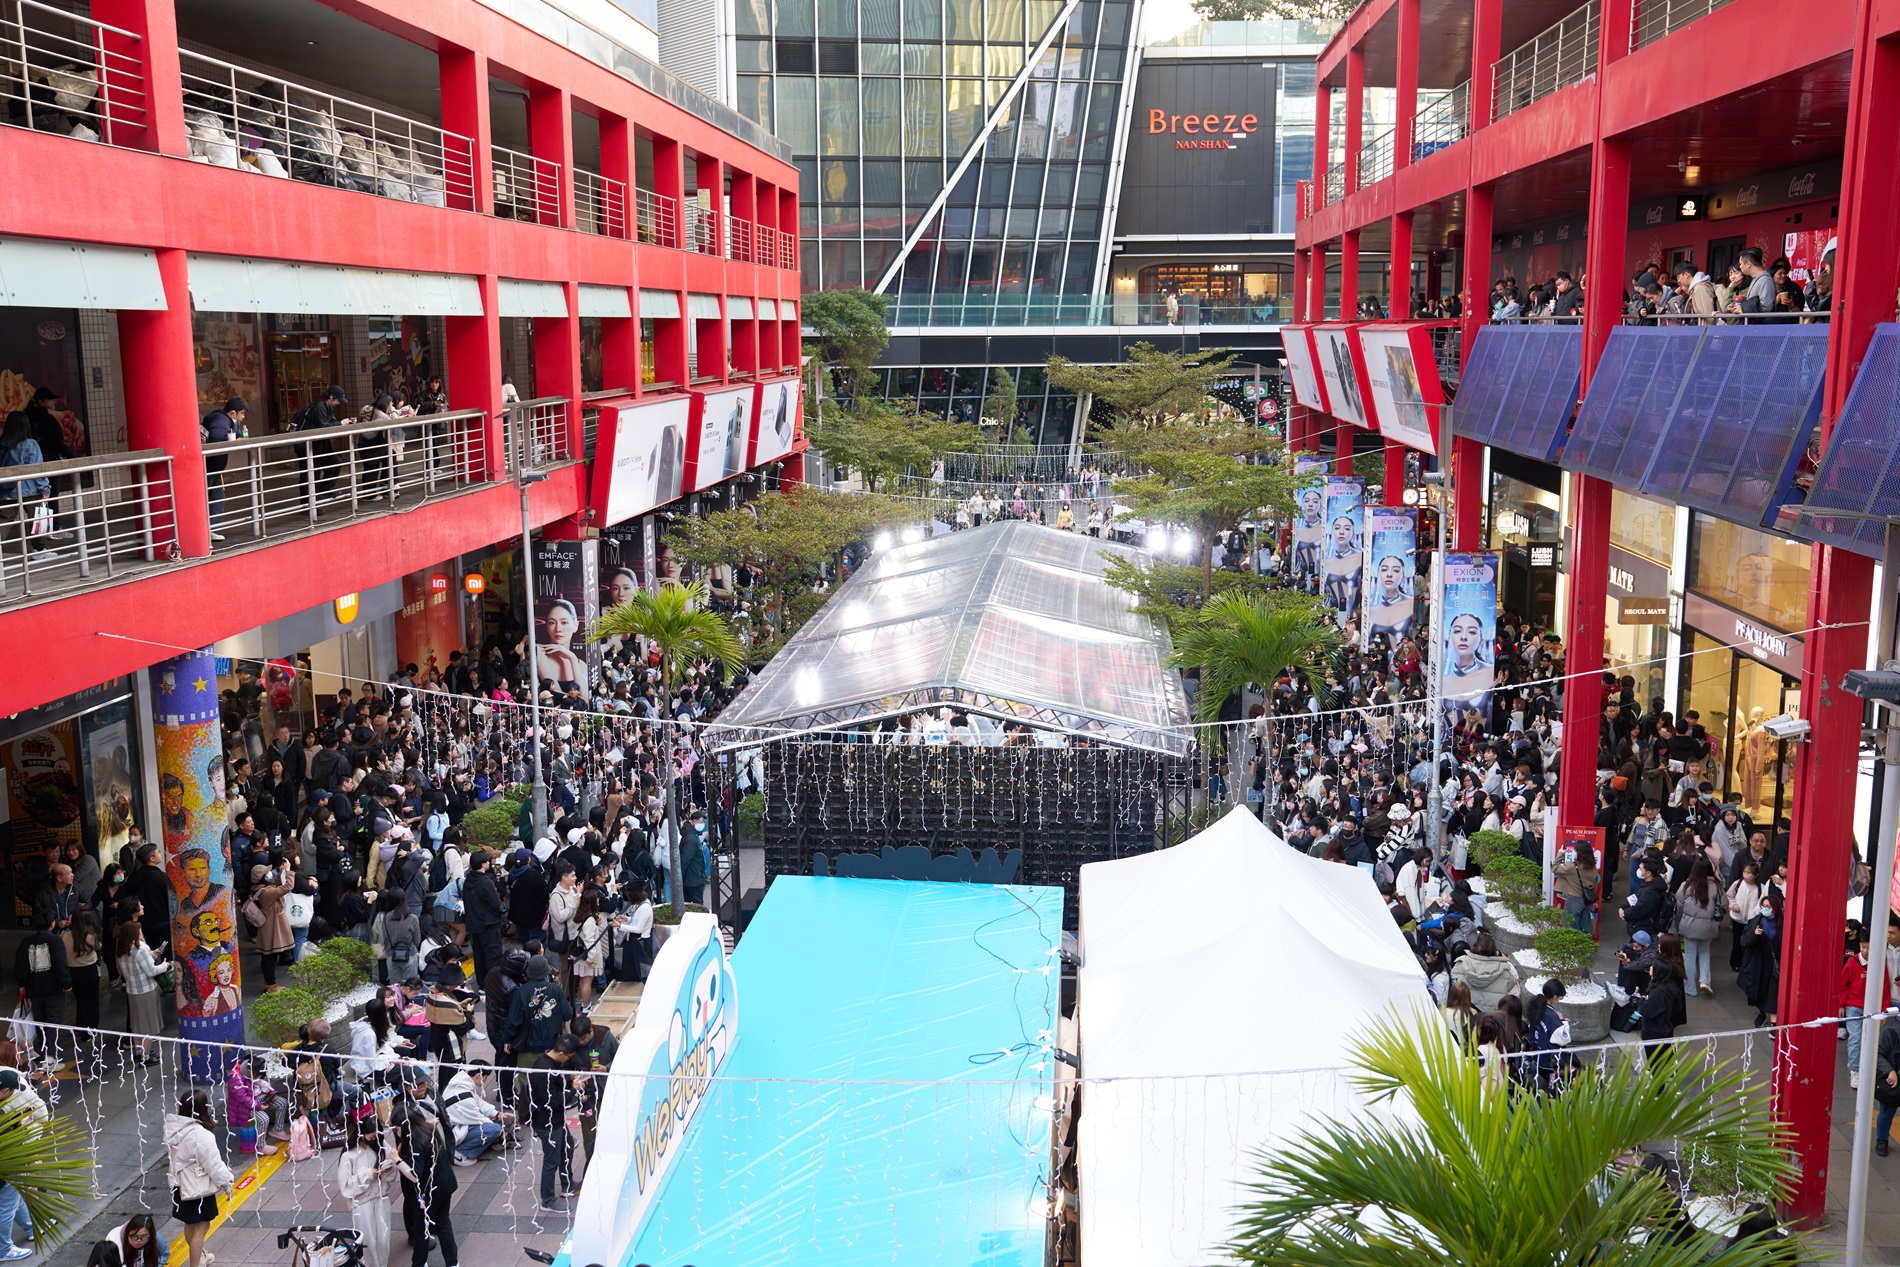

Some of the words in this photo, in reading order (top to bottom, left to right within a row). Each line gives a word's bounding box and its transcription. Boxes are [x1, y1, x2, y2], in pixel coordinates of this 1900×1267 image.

[1149, 109, 1258, 134] Breeze
[1175, 140, 1198, 150] NAN
[1199, 140, 1230, 150] SHAN
[544, 561, 571, 569] 菲斯波
[538, 574, 557, 597] I'M
[1609, 565, 1635, 593] MATE
[1735, 619, 1764, 646] PEACH
[1762, 632, 1787, 657] JOHN
[634, 1025, 709, 1196] WePlay
